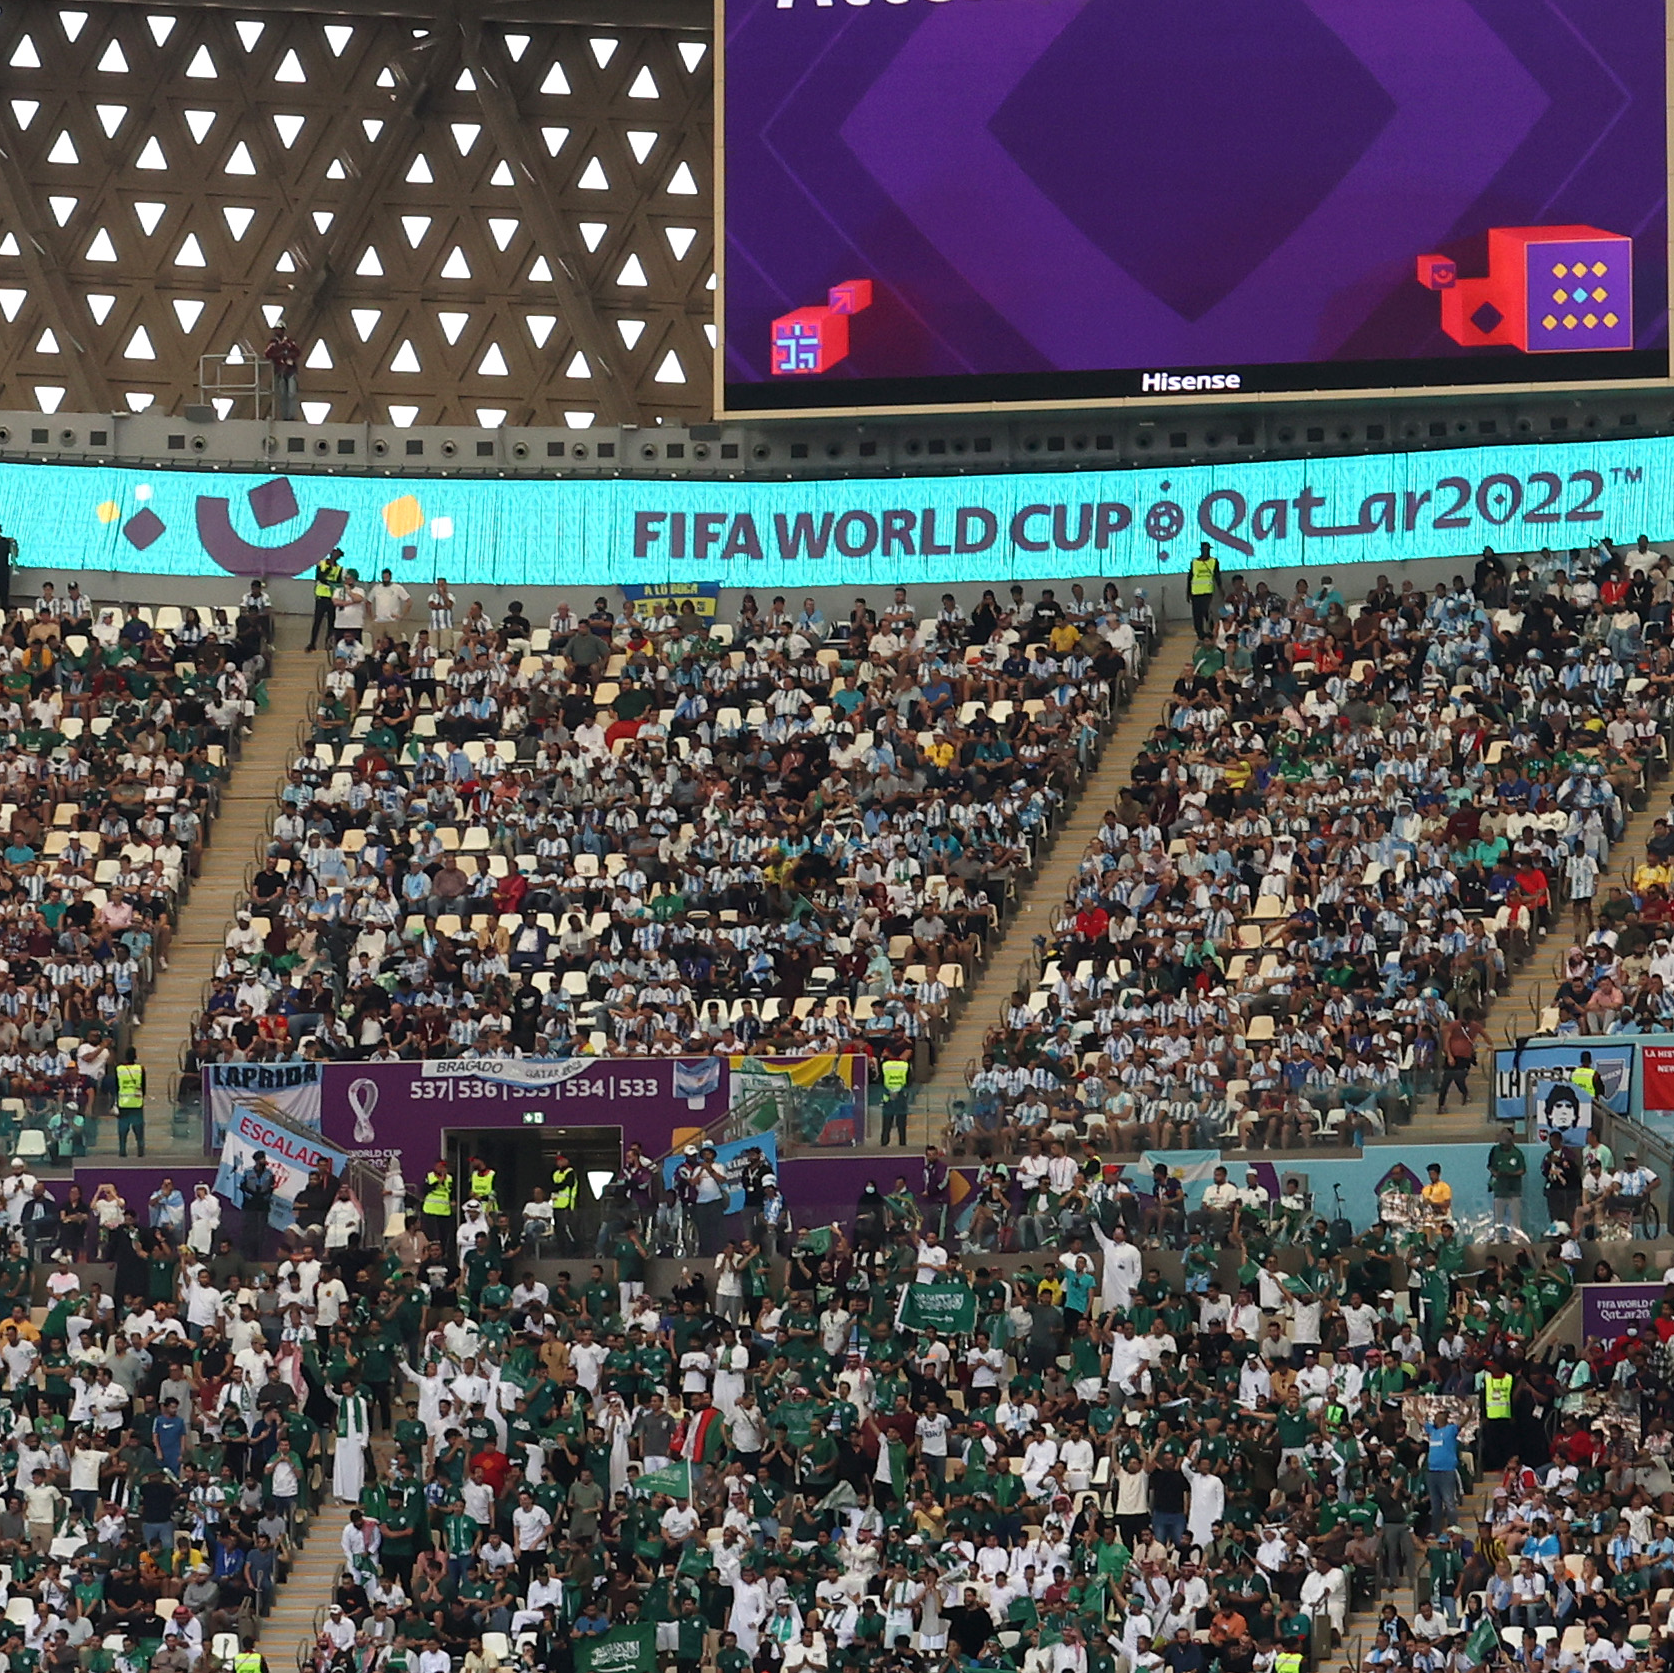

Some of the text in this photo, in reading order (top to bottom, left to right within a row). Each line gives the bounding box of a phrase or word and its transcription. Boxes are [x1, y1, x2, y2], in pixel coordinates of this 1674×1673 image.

[1141, 371, 1241, 393] Hisense
[633, 510, 764, 560] FIFA
[773, 506, 999, 560] WORLD
[1008, 501, 1133, 552] CUP
[1645, 1050, 1656, 1058] LA
[214, 1062, 318, 1089] LAPRIDA
[436, 1060, 503, 1074] BRAGADO
[410, 1081, 448, 1099] 537
[458, 1081, 497, 1098] 536
[565, 1079, 605, 1097] 534
[619, 1079, 658, 1097] 533
[1597, 1300, 1616, 1310] FIFA
[1617, 1299, 1647, 1309] WORLD
[1600, 1309, 1651, 1322] Qatar20
